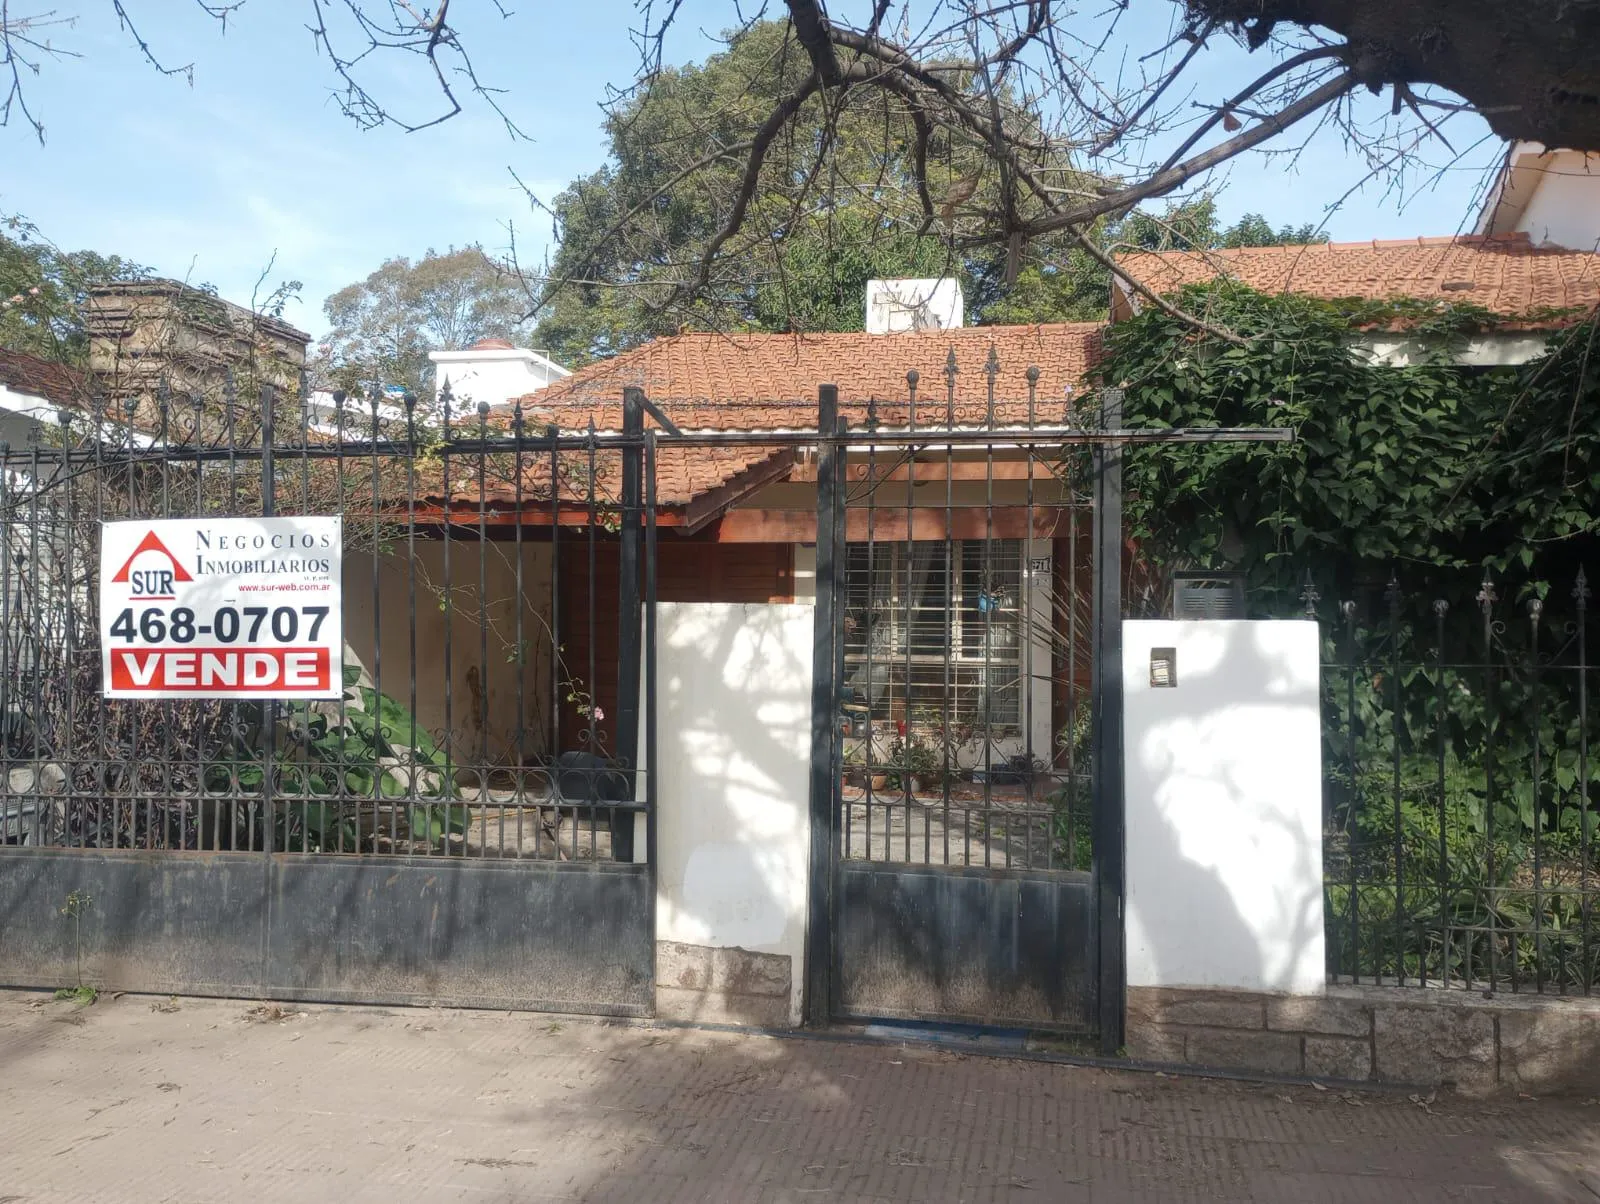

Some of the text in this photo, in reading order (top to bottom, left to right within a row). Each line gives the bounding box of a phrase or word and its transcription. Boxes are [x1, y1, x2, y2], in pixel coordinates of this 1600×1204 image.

[196, 530, 330, 550] NEGOCIOS
[196, 554, 330, 575] INMOBILIARIOS
[132, 570, 175, 595] SUR
[239, 583, 331, 592] www.sur-web.com.ar
[110, 606, 330, 644] 468-0707
[121, 652, 319, 687] VENDE
